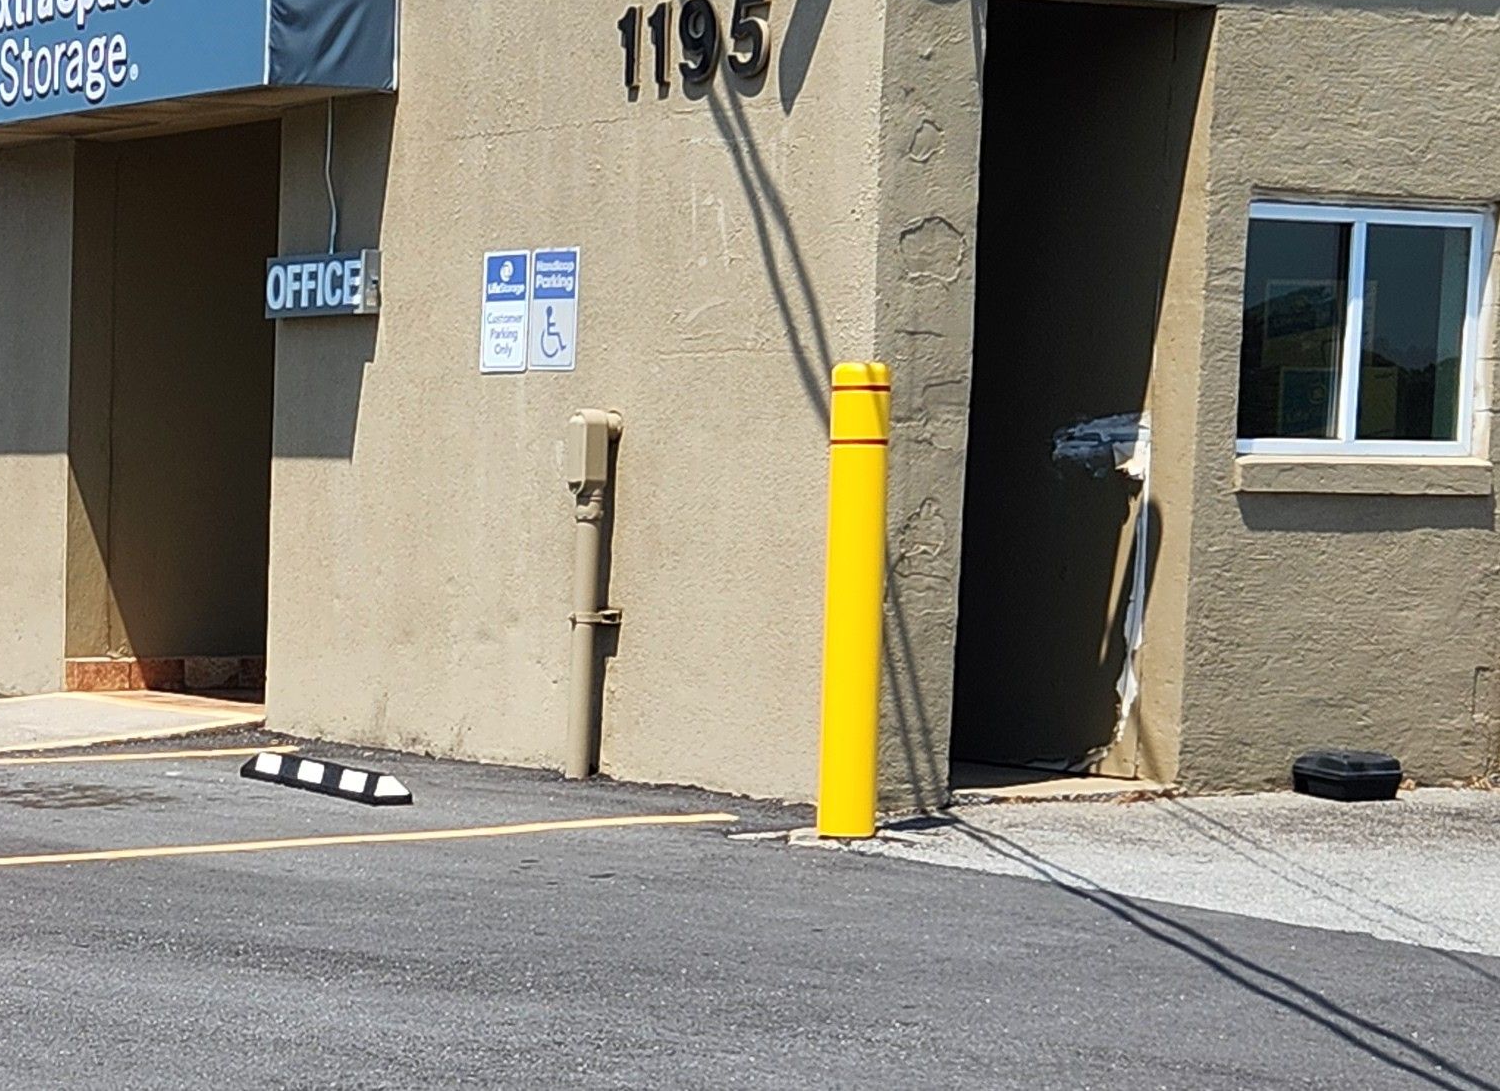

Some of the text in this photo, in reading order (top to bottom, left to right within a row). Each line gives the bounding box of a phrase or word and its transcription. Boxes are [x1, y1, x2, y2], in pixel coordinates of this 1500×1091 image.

[266, 260, 361, 310] OFFICE
[536, 274, 574, 291] Parking
[487, 312, 524, 324] Customer
[489, 328, 519, 343] Parking
[494, 343, 513, 358] Only
